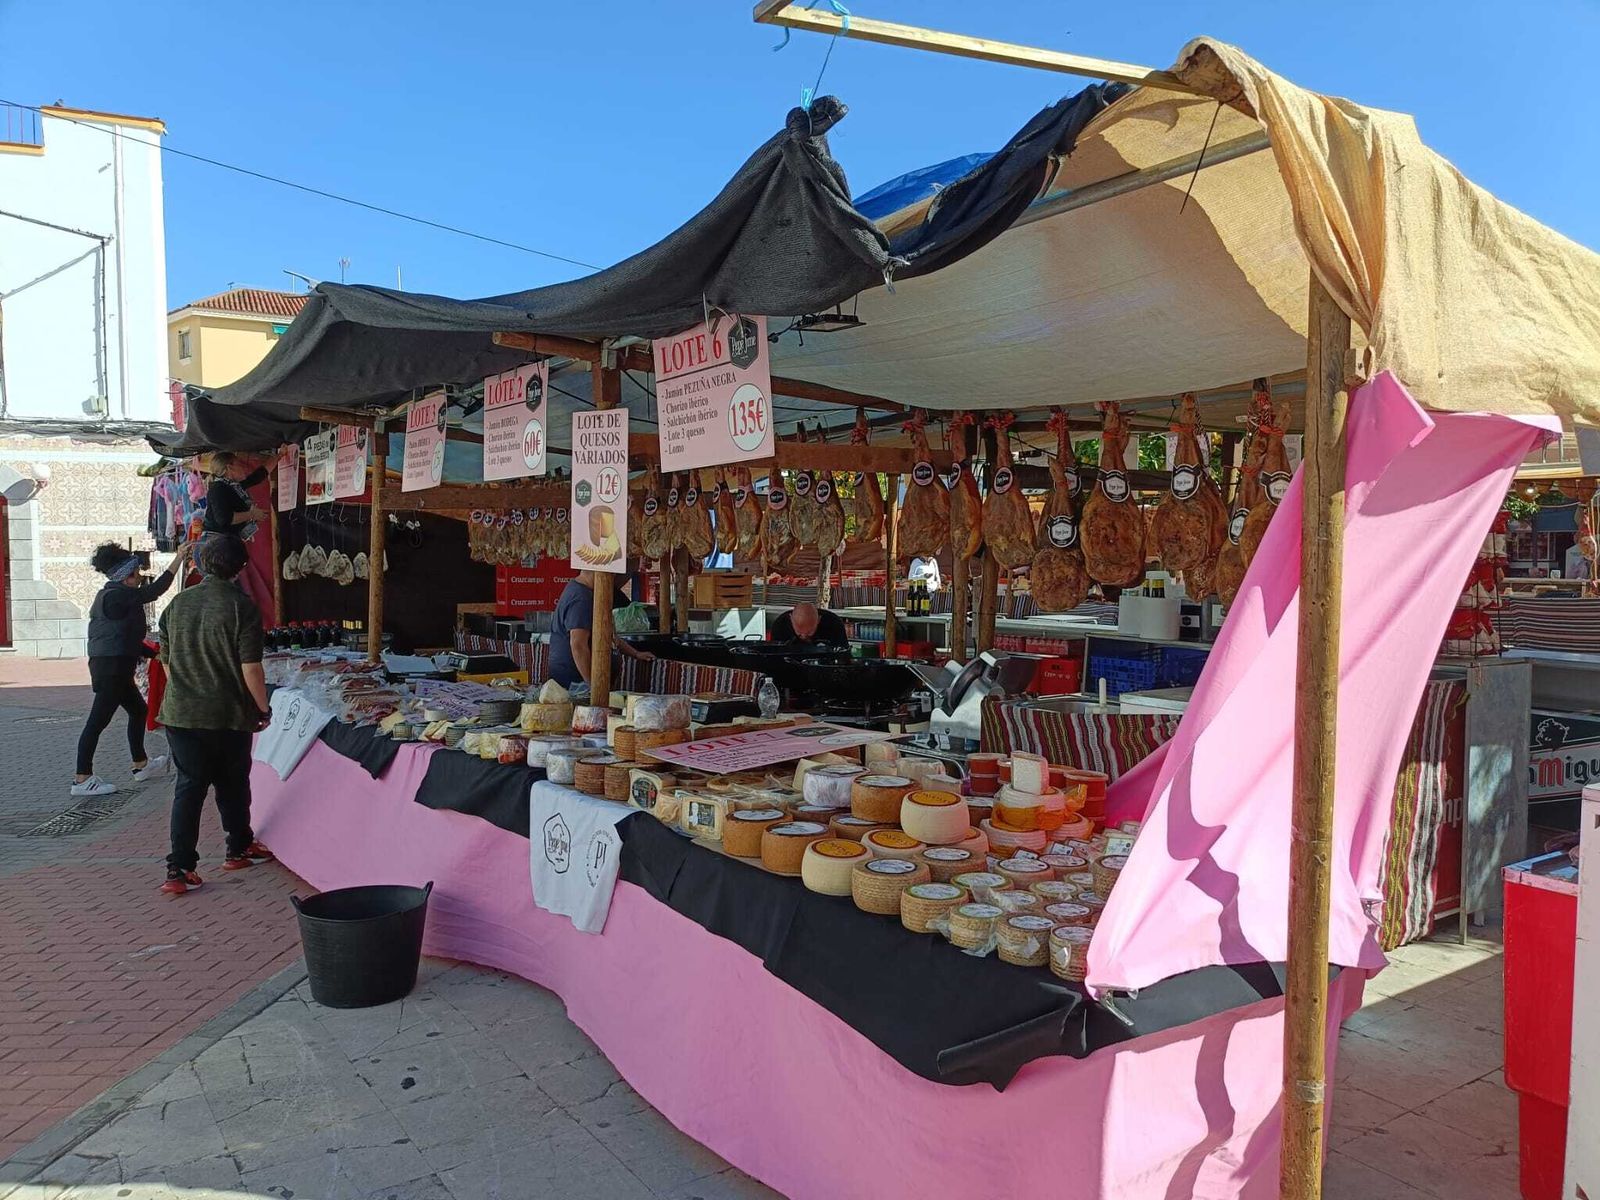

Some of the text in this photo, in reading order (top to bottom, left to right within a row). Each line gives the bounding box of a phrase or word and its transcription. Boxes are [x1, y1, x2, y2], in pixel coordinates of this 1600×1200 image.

[661, 328, 722, 374] LOTE 6
[488, 378, 515, 405] LOTE
[517, 375, 523, 399] 2
[684, 376, 711, 396] PEZUÑA
[711, 372, 737, 388] NEGRA
[410, 404, 431, 428] LOTE
[578, 413, 621, 429] LOTE DE
[731, 397, 766, 437] 135€
[524, 429, 542, 457] 60€
[579, 431, 621, 450] QUESOS
[667, 426, 706, 441] Lote 3 quesos
[574, 449, 627, 464] VARIADOS
[598, 473, 619, 496] 12€
